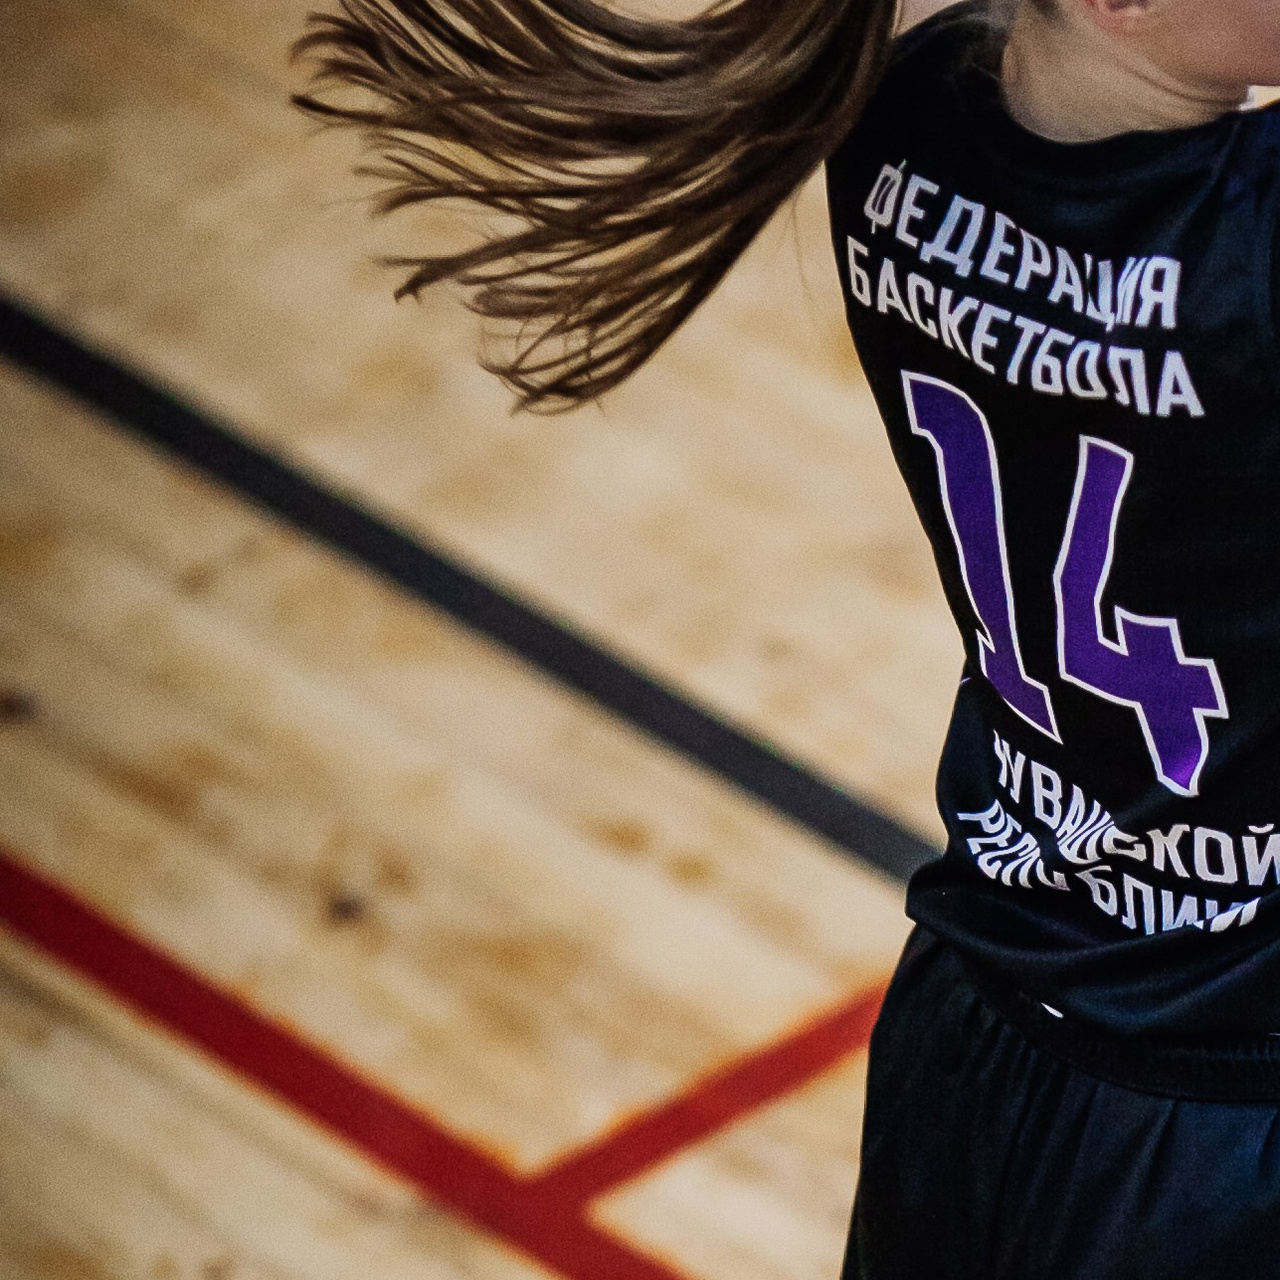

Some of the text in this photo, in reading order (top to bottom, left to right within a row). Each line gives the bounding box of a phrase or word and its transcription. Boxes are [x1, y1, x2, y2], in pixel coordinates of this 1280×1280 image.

[846, 234, 1206, 418] БАСКЕТБОЛА
[862, 159, 1182, 333] ФЕДЕРАЦИЯ
[900, 369, 1230, 797] 14
